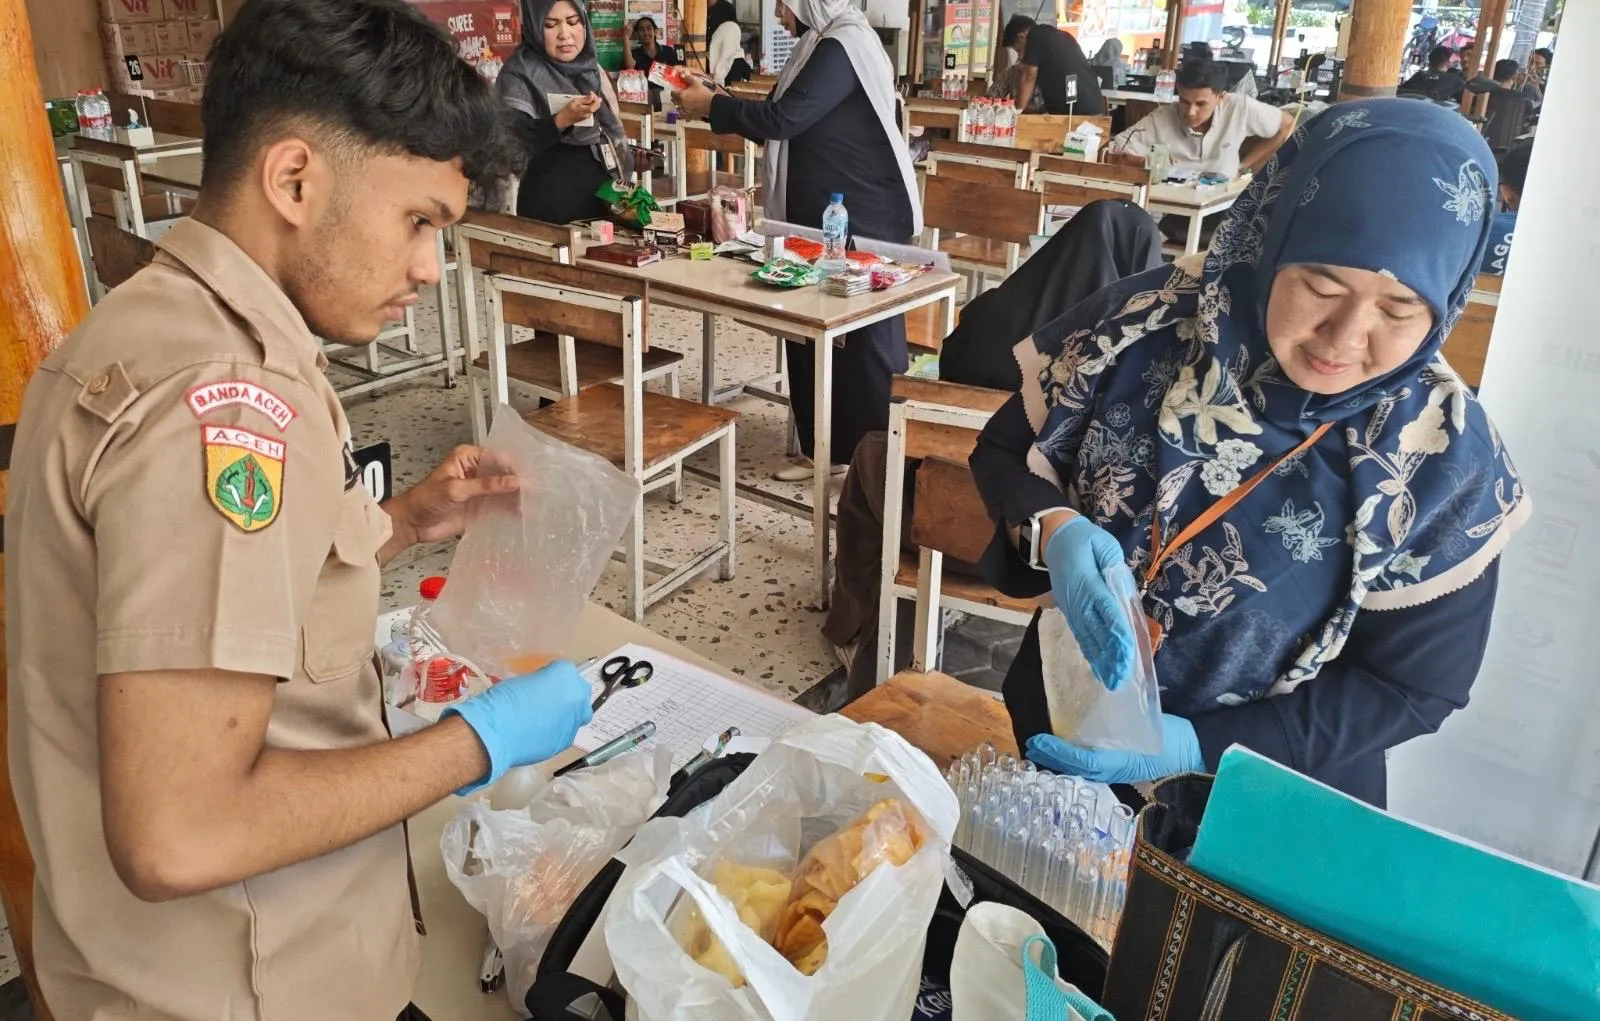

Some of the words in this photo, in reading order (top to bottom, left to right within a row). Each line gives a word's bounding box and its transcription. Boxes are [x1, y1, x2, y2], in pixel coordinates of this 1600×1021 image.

[447, 13, 475, 34] SUREE
[128, 60, 141, 75] 26
[144, 58, 177, 79] Vit
[195, 386, 251, 408] BANDA
[254, 391, 289, 424] ACEH
[212, 429, 280, 457] ACEH
